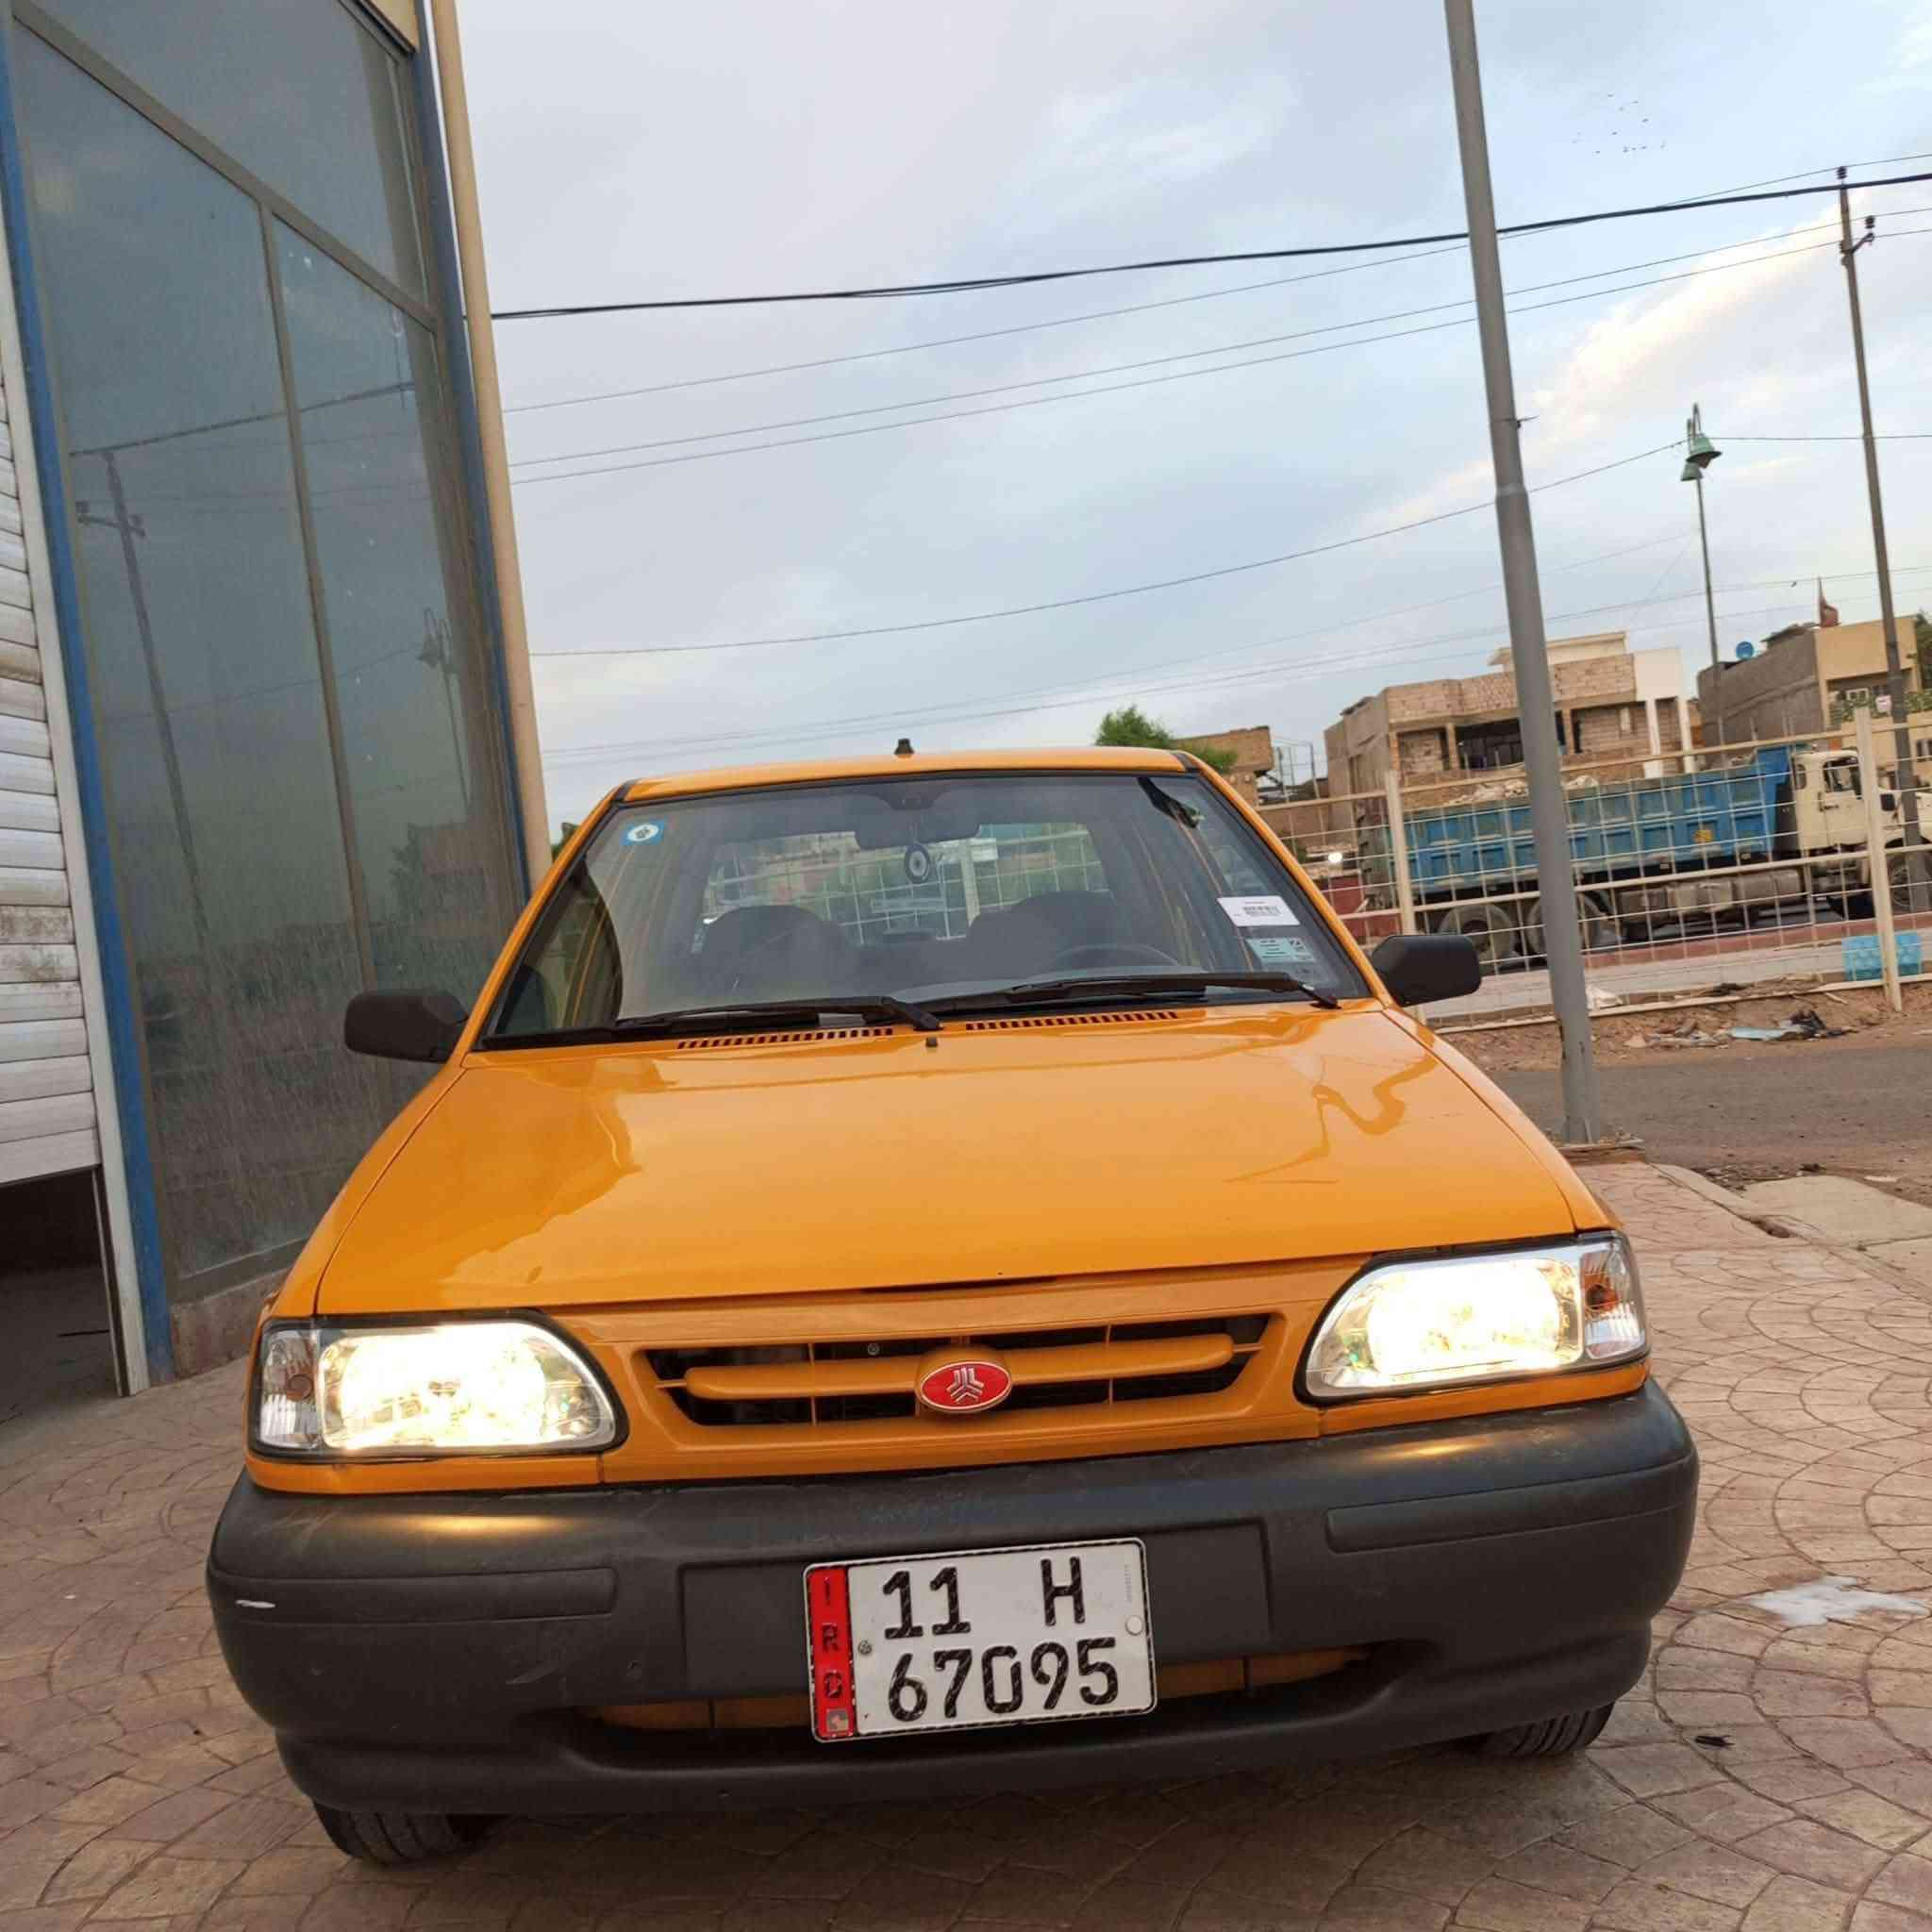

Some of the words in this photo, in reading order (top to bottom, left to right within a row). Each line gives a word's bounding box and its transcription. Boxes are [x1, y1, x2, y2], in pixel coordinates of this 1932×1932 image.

[882, 1566, 972, 1640] 11
[1040, 1556, 1086, 1626] H
[888, 1637, 1120, 1723] 67095
